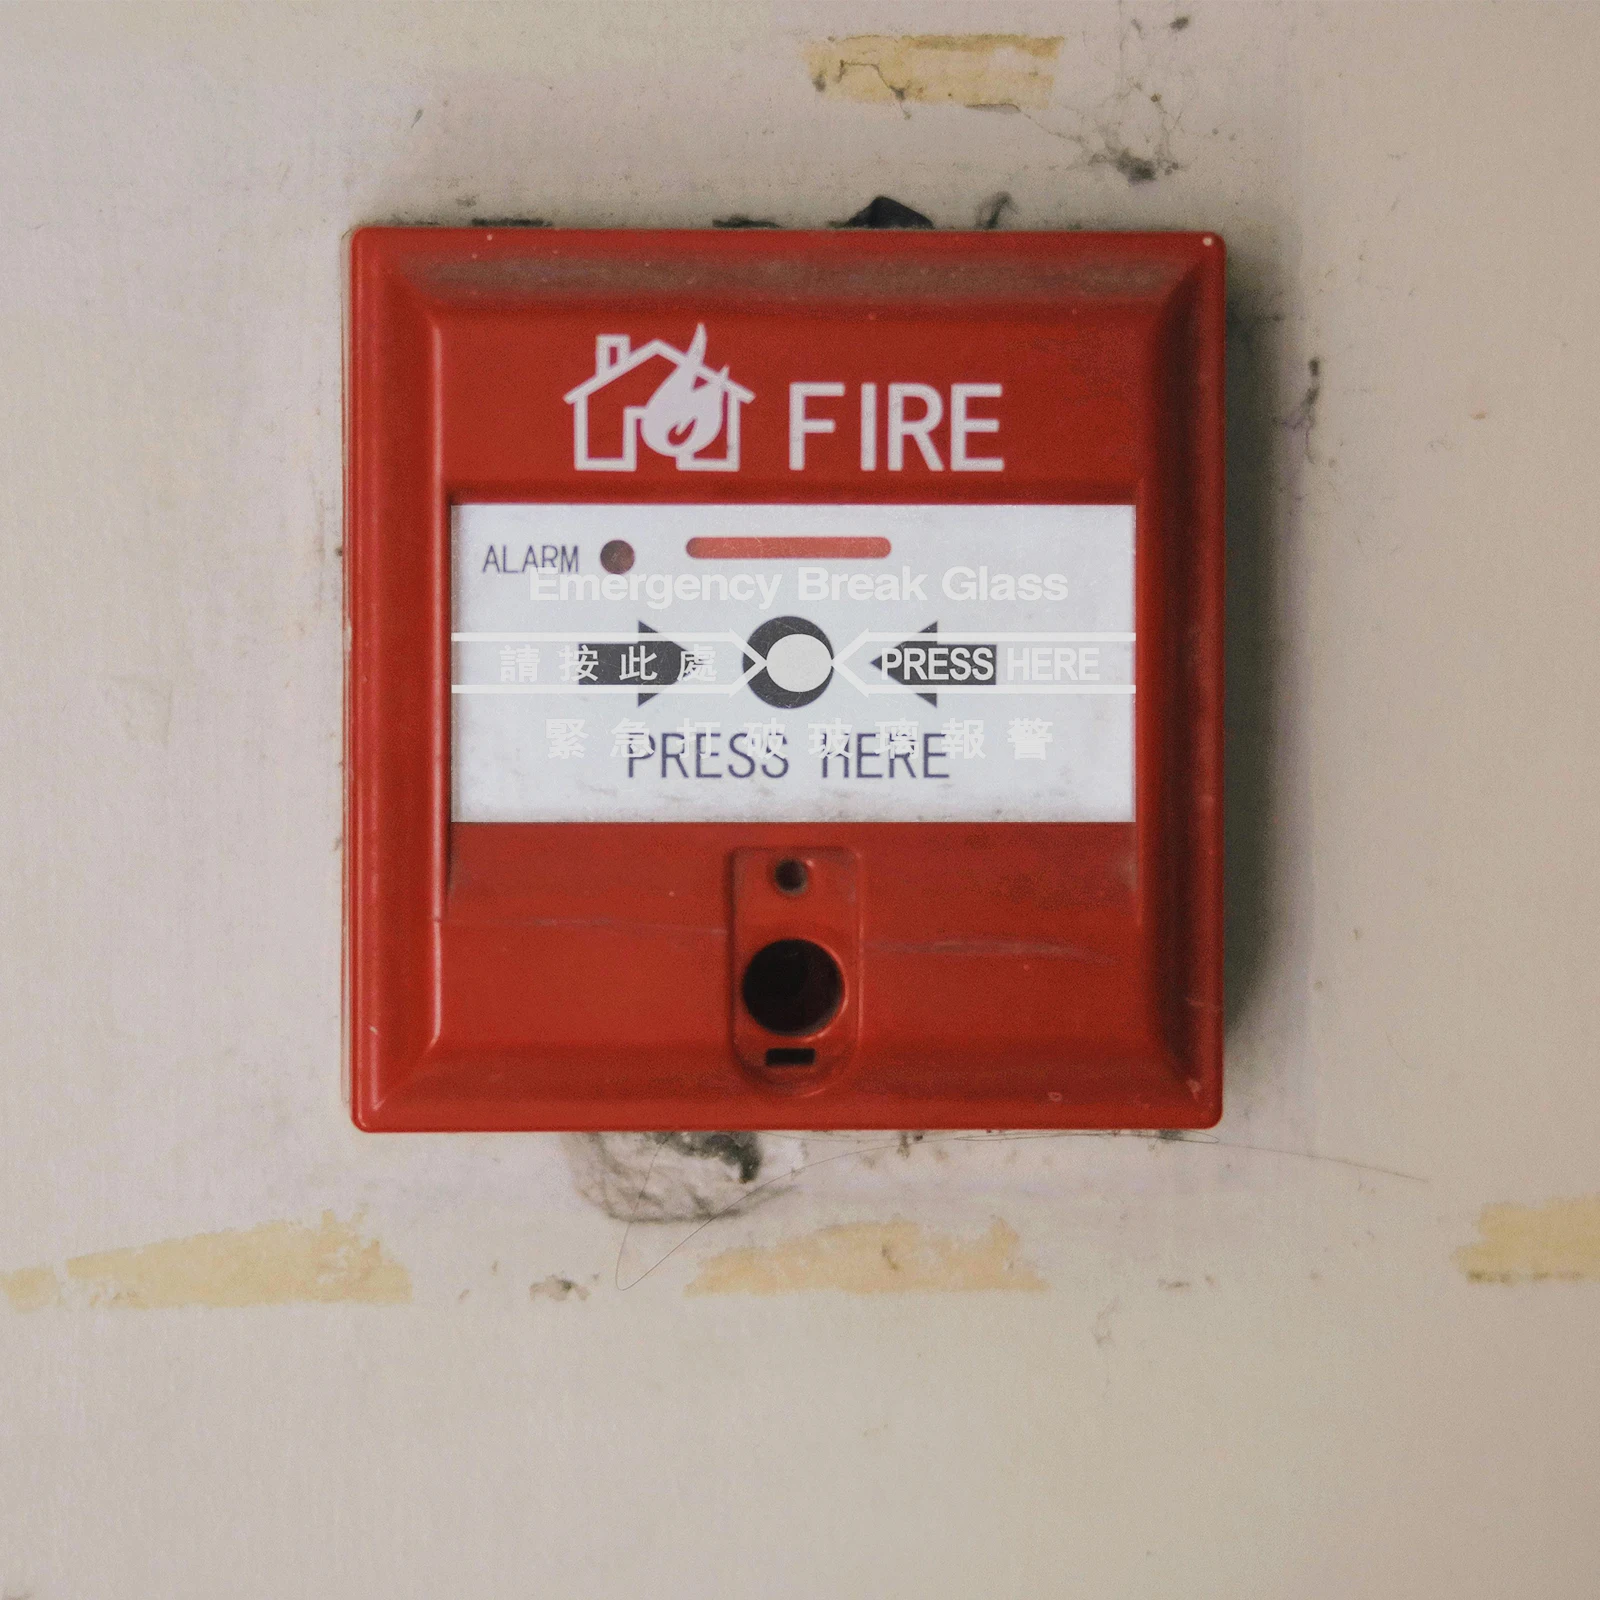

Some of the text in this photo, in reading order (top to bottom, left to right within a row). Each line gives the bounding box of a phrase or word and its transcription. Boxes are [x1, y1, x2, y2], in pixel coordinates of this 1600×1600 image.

[788, 382, 1006, 473] FIRE
[482, 544, 580, 575] ALARM
[529, 565, 1069, 610] Emergency Break Glass
[499, 644, 718, 683] 請按此處
[880, 647, 1101, 682] PRESS HERE
[627, 732, 950, 779] PRESS HERE
